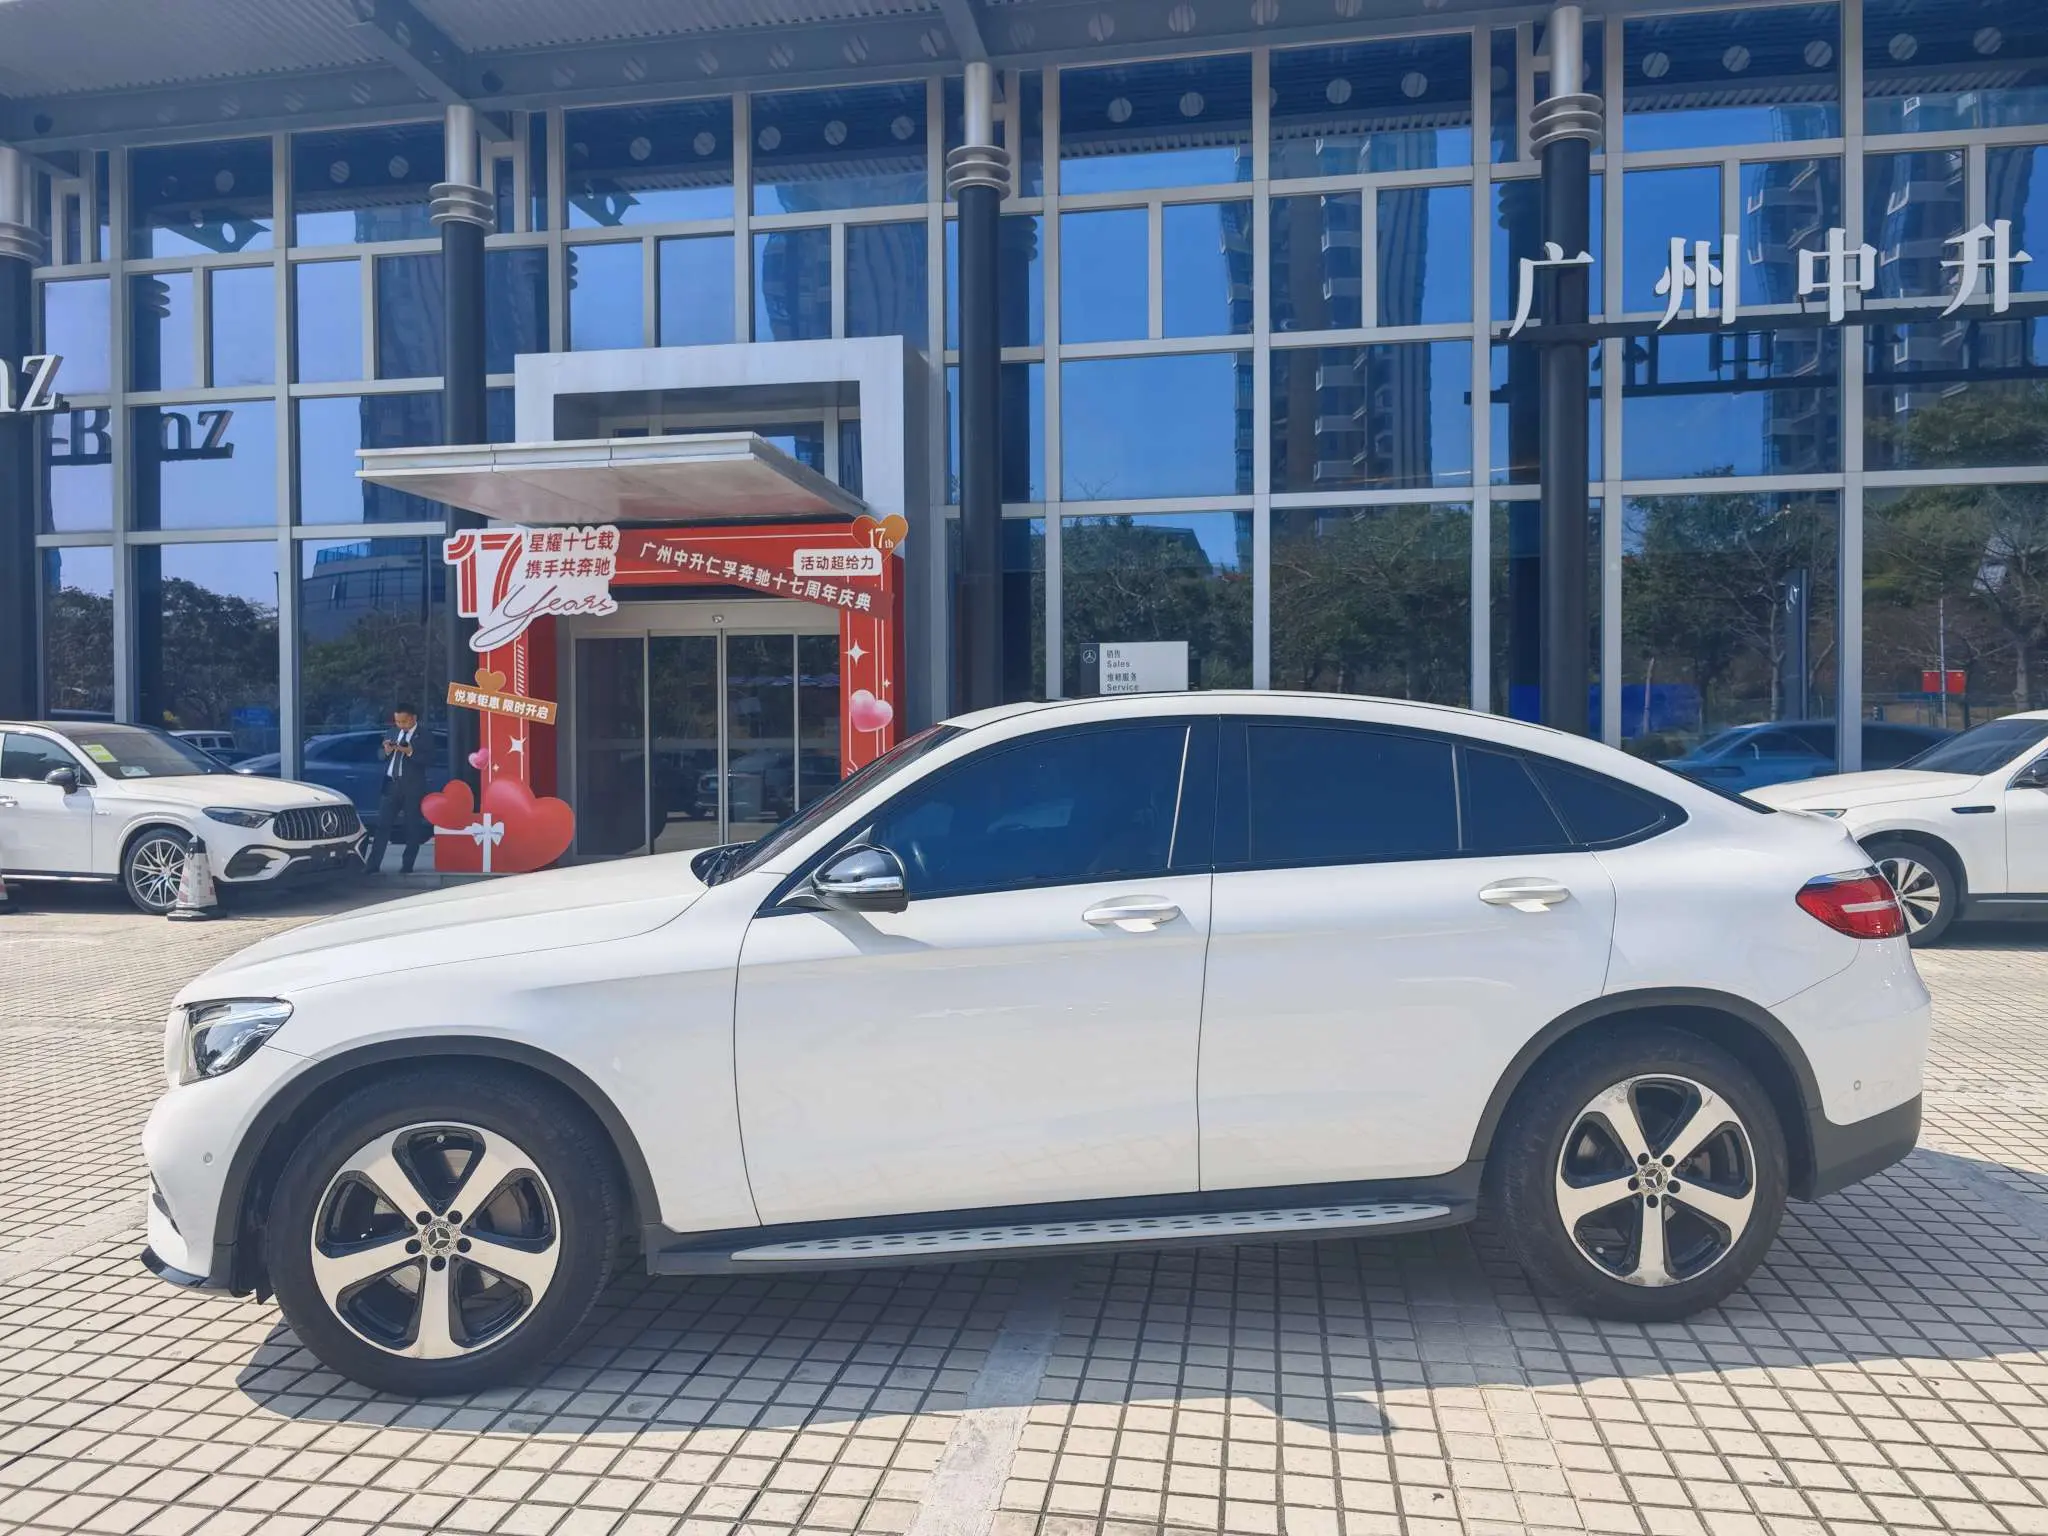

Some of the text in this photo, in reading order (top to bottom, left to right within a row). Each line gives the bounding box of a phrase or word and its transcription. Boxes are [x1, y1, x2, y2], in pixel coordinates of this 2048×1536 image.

[1508, 219, 2034, 338] 广州中升
[528, 530, 615, 553] 星耀十七载
[447, 533, 523, 616] 17
[524, 557, 612, 580] 携手共奔驰
[799, 555, 875, 571] 活动超给力
[639, 541, 873, 612] 广州中升仁孚奔驰十七周年庆典
[474, 584, 613, 648] Years
[1106, 660, 1131, 668] Sales
[1106, 683, 1140, 692] Service
[502, 698, 549, 720] 限时开启
